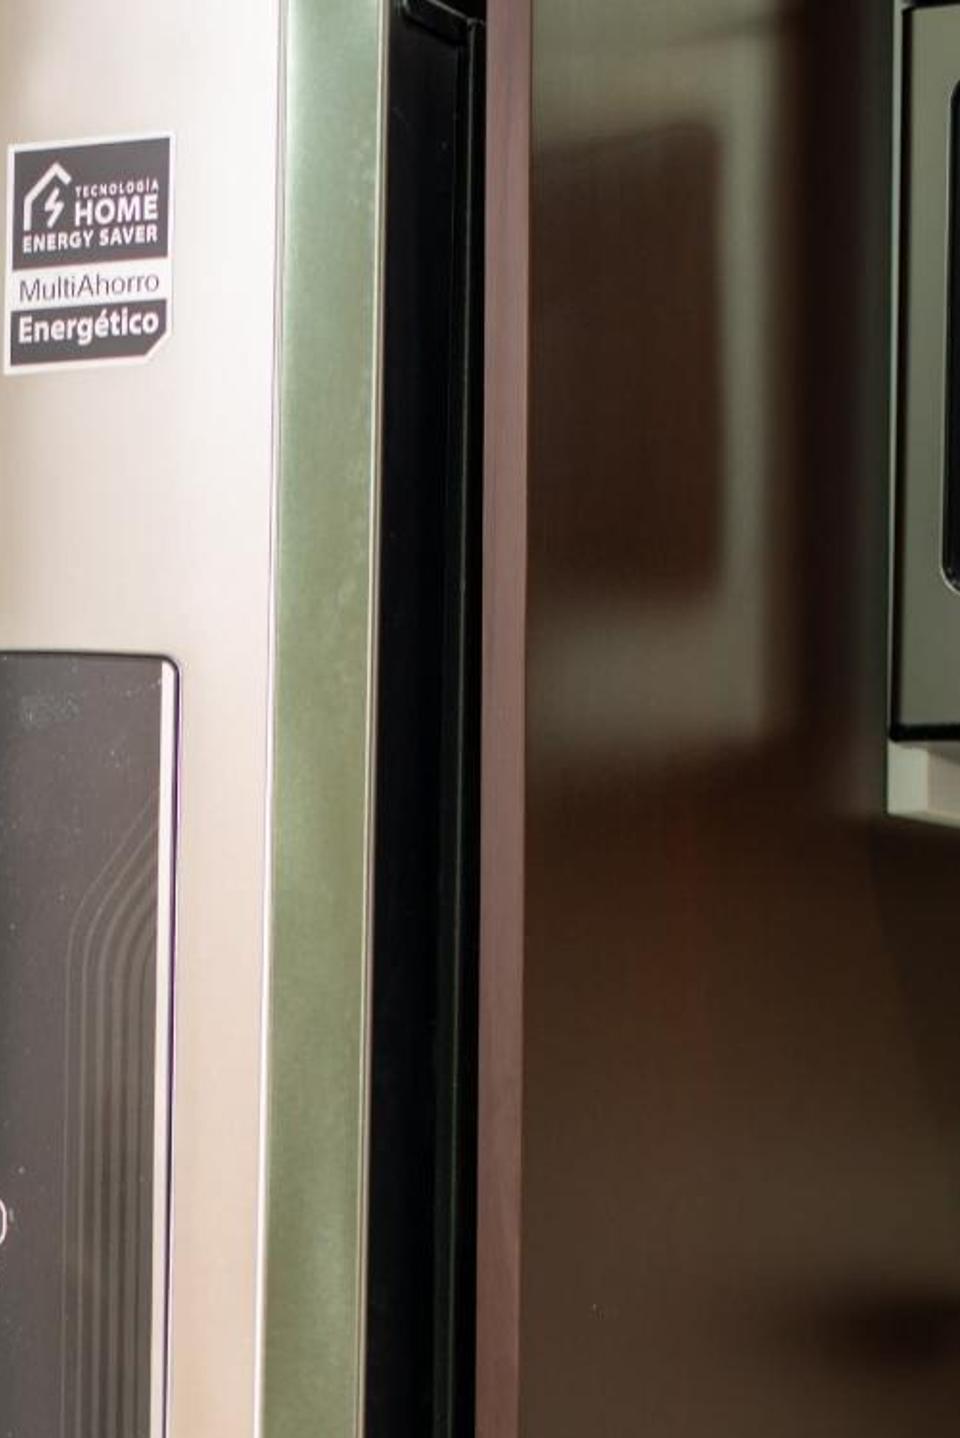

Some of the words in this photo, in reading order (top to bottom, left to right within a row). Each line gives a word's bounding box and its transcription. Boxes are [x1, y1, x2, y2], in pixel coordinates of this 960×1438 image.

[74, 194, 158, 226] HOME
[22, 230, 93, 254] ENERGY
[99, 224, 158, 246] SAVER
[19, 273, 160, 302] MultiAhorro
[18, 307, 160, 346] Energético
